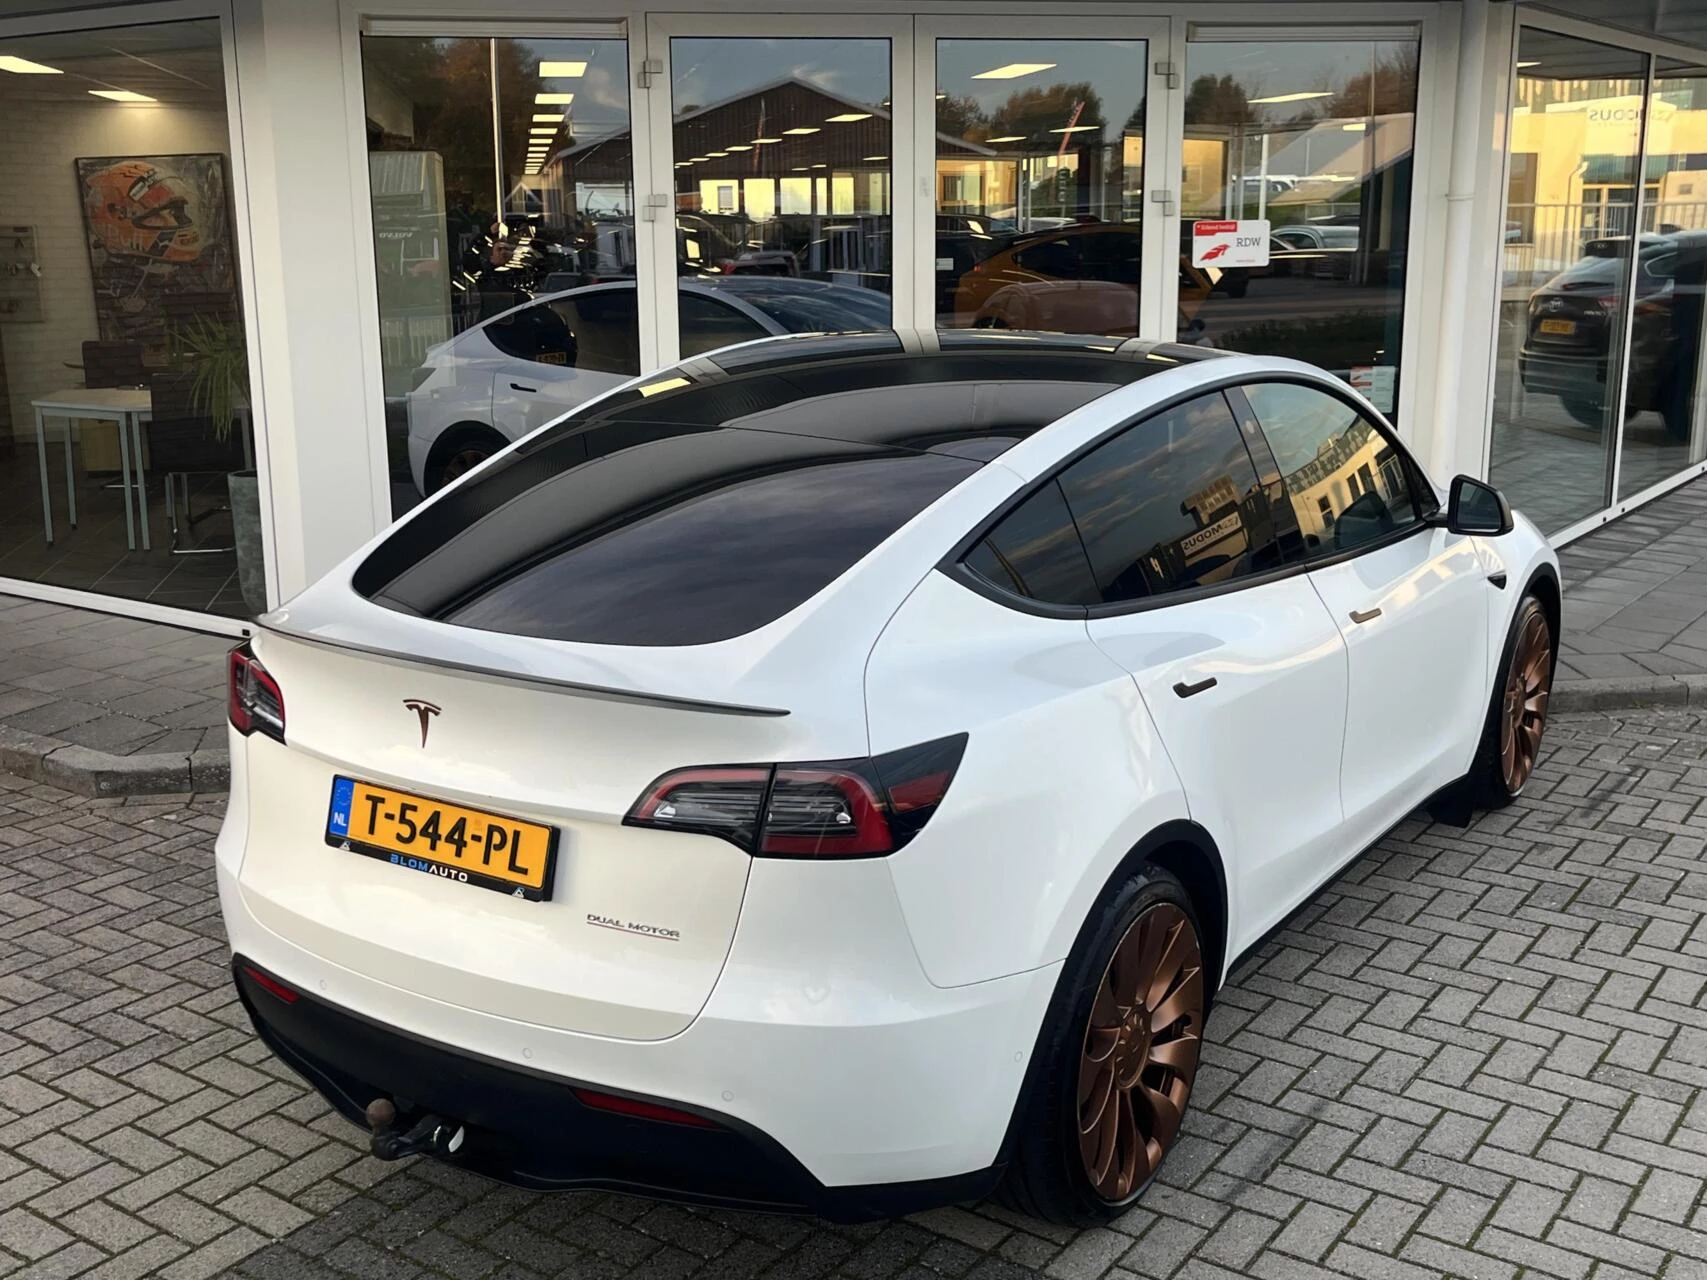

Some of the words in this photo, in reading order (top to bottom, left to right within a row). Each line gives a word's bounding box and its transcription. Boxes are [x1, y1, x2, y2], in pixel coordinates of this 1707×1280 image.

[1236, 237, 1261, 248] RDW
[333, 811, 347, 827] NL
[365, 794, 529, 876] T-544-PL
[390, 853, 468, 883] BLOMAUTO
[587, 914, 625, 928] DUAL
[628, 922, 681, 938] MOTOR
